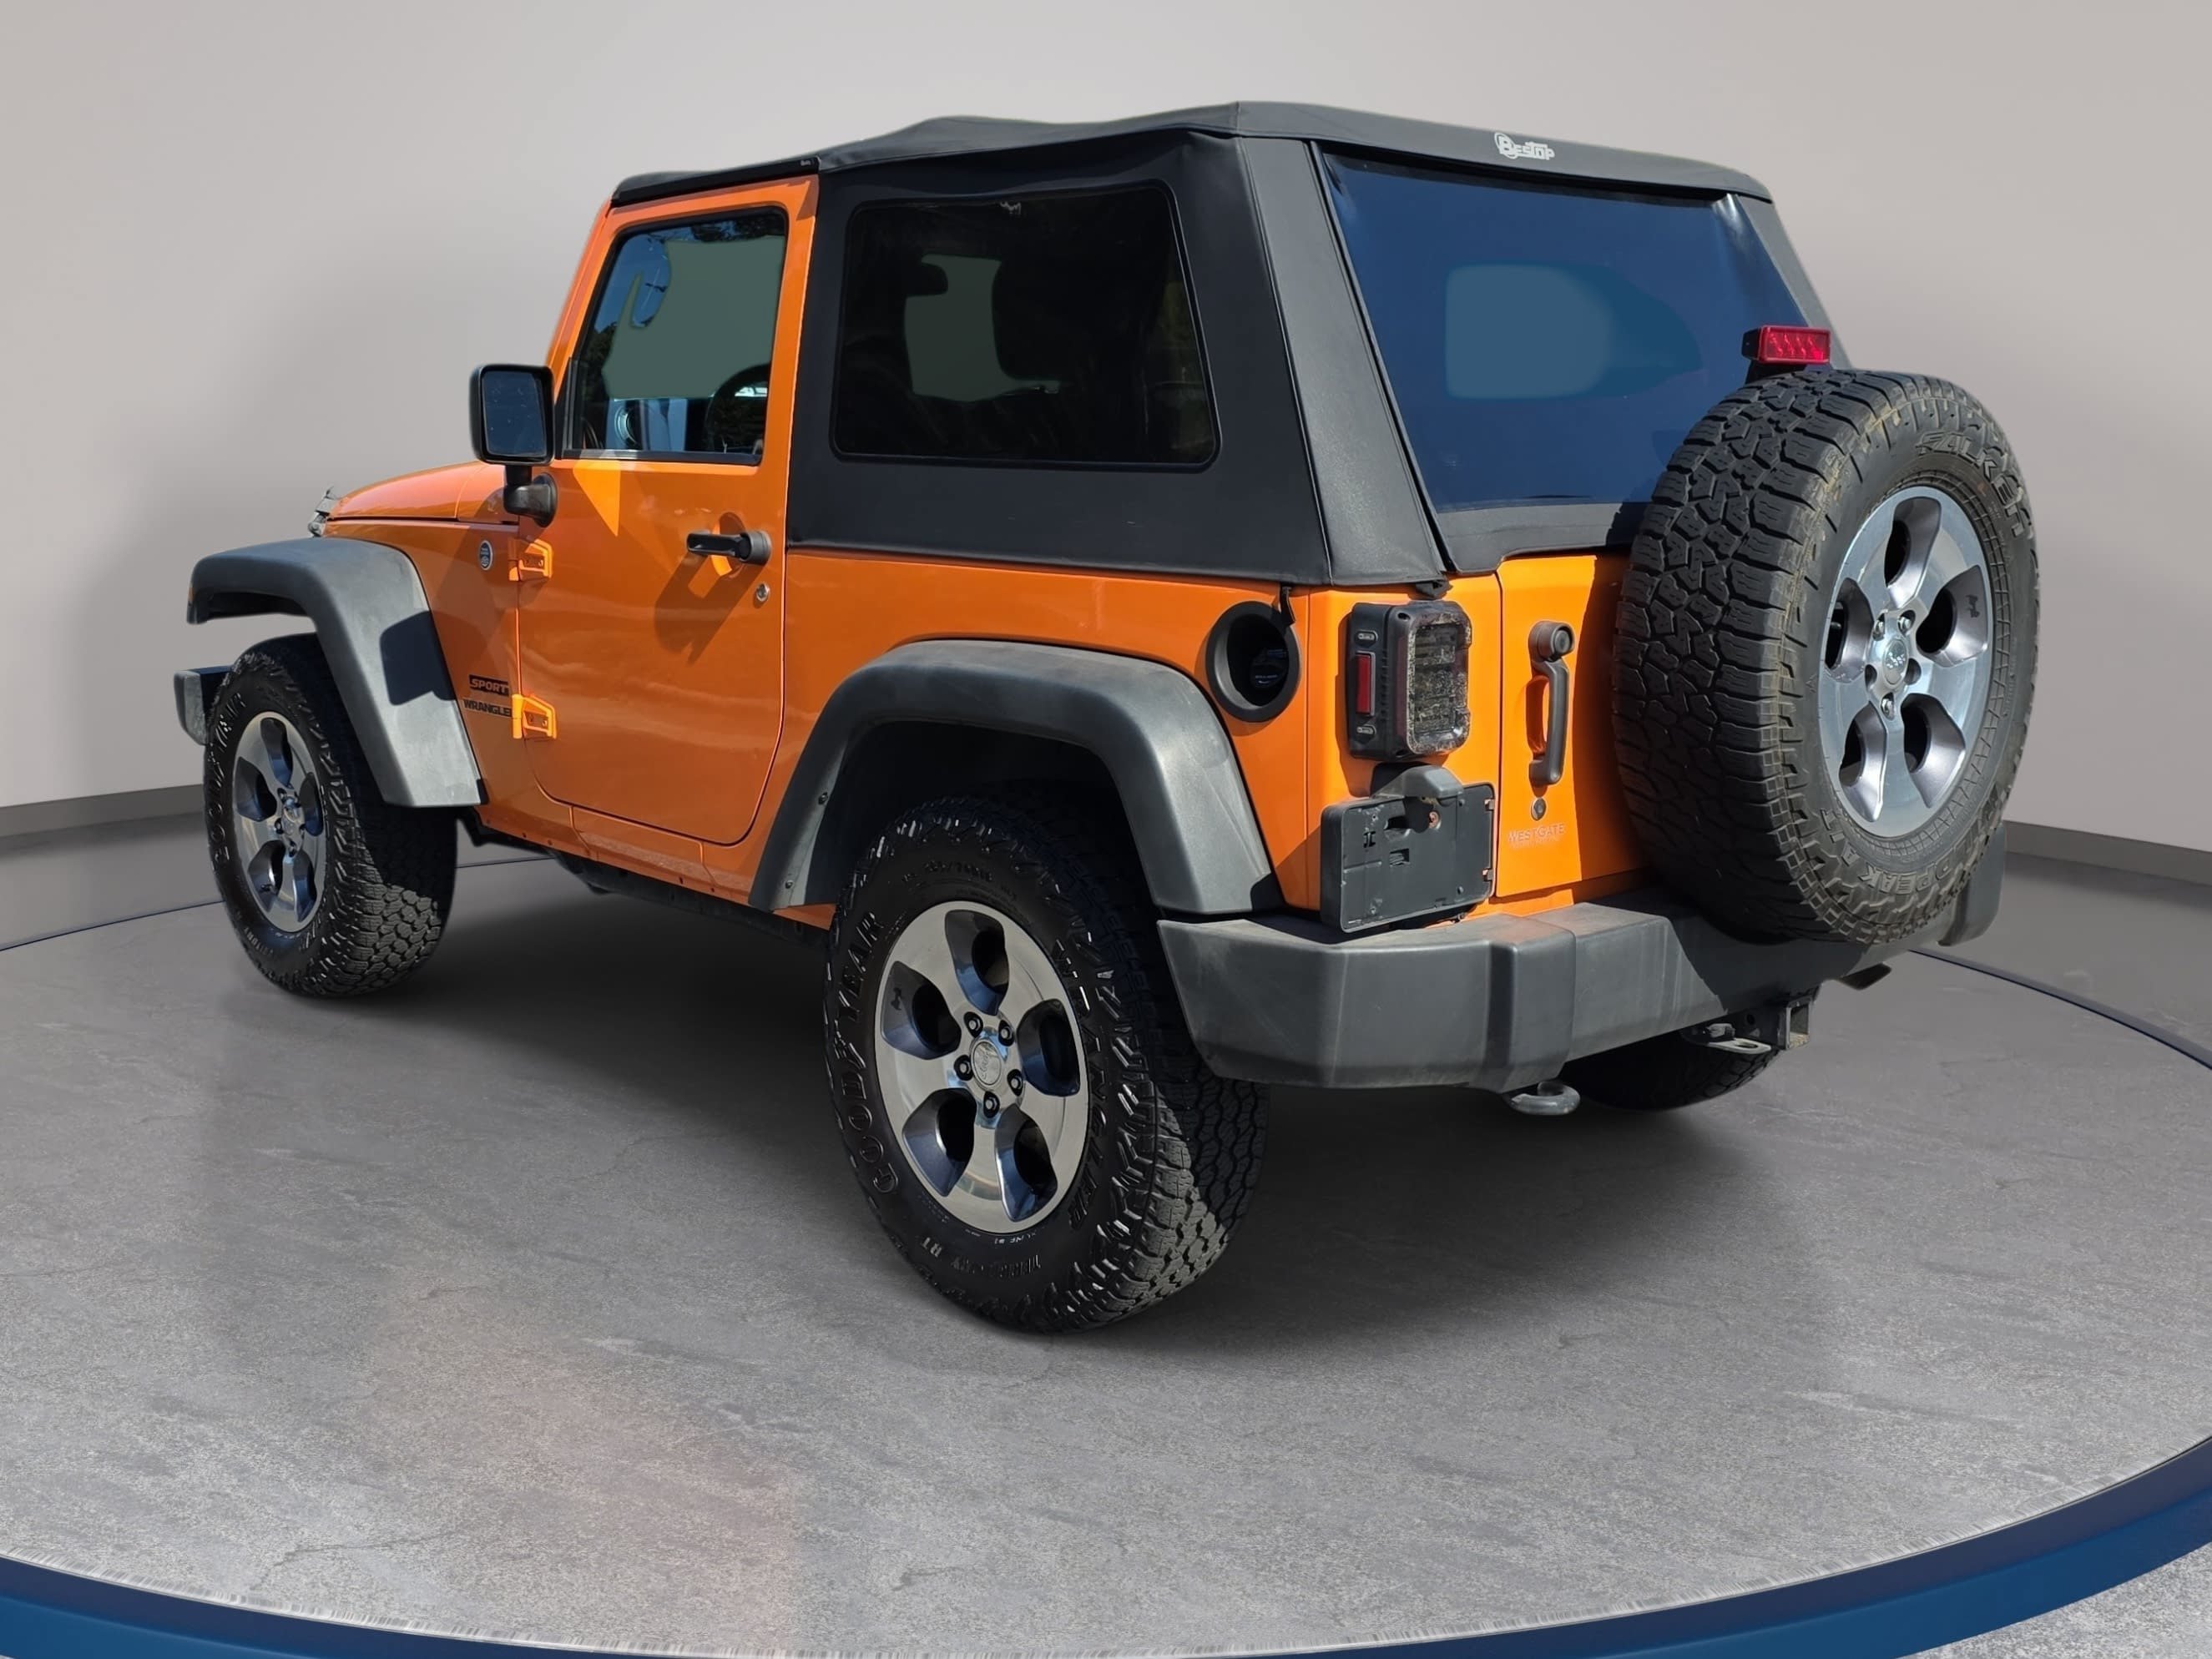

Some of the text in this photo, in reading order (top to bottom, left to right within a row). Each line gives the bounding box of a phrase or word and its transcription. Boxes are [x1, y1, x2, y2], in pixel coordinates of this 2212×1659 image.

[1915, 431, 2025, 537] FALKEN
[462, 698, 513, 718] WRANGLE
[471, 677, 510, 694] SPORT
[833, 910, 899, 1195] GOODYEAR
